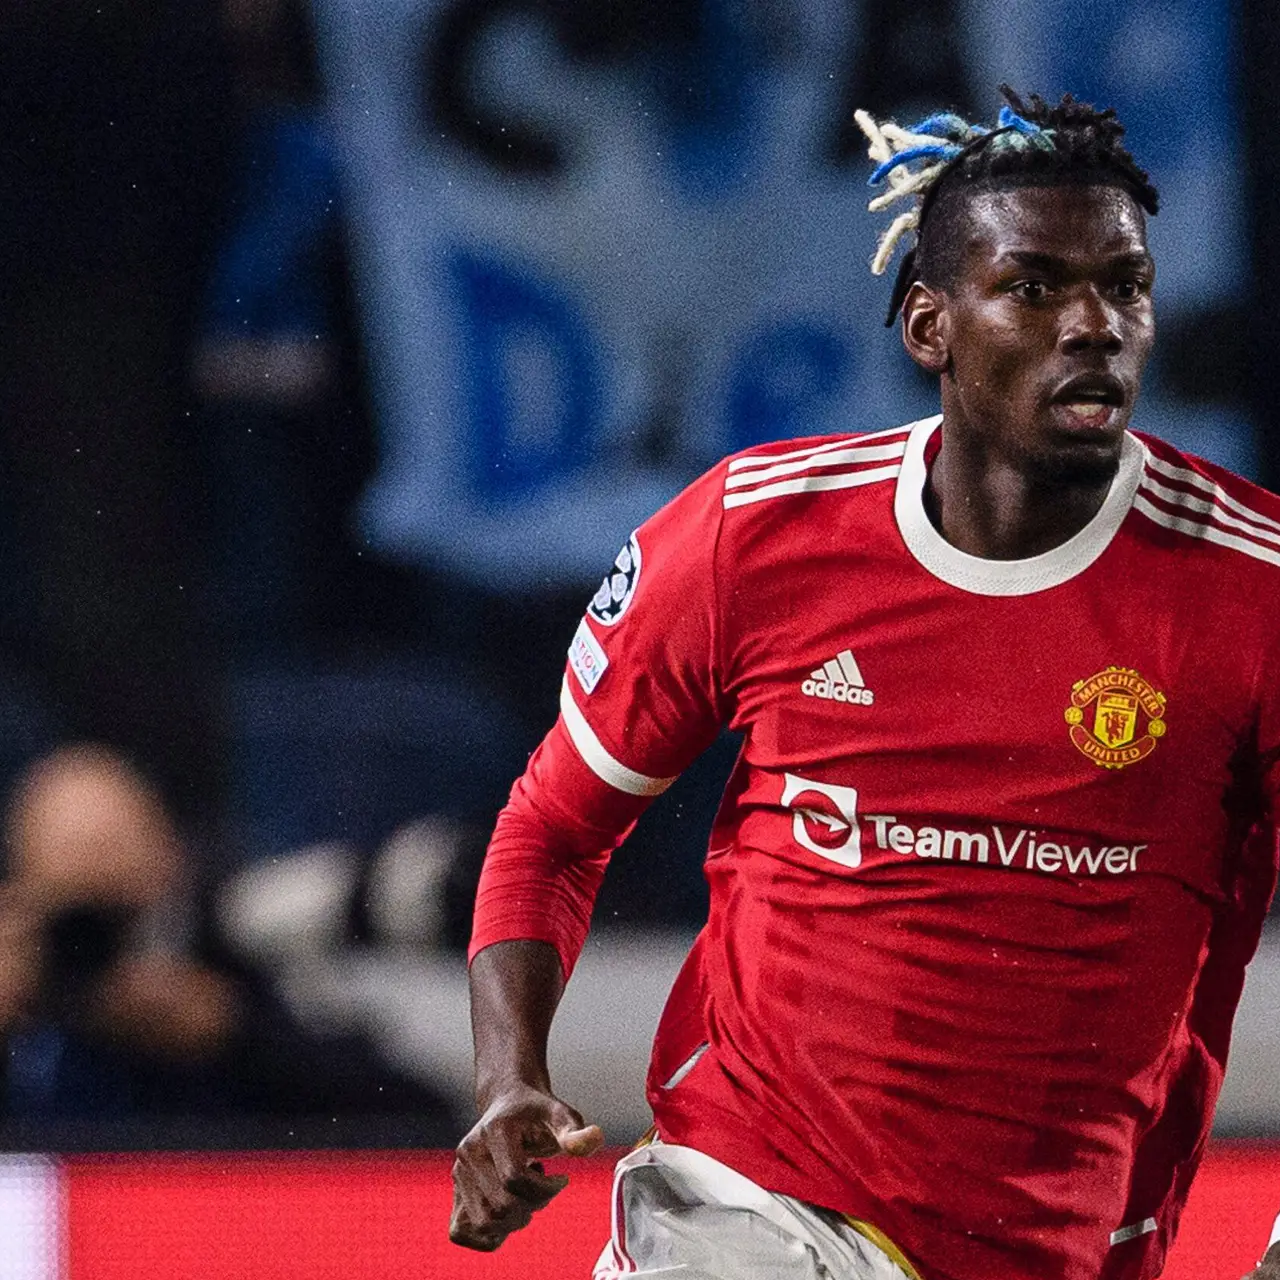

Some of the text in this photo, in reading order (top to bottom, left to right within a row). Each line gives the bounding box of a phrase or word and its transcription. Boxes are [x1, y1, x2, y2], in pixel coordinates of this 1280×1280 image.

[801, 679, 875, 706] adidas
[1079, 673, 1159, 713] MANCHESTER
[1083, 740, 1140, 762] UNITED
[863, 814, 1148, 875] TeamViewer
